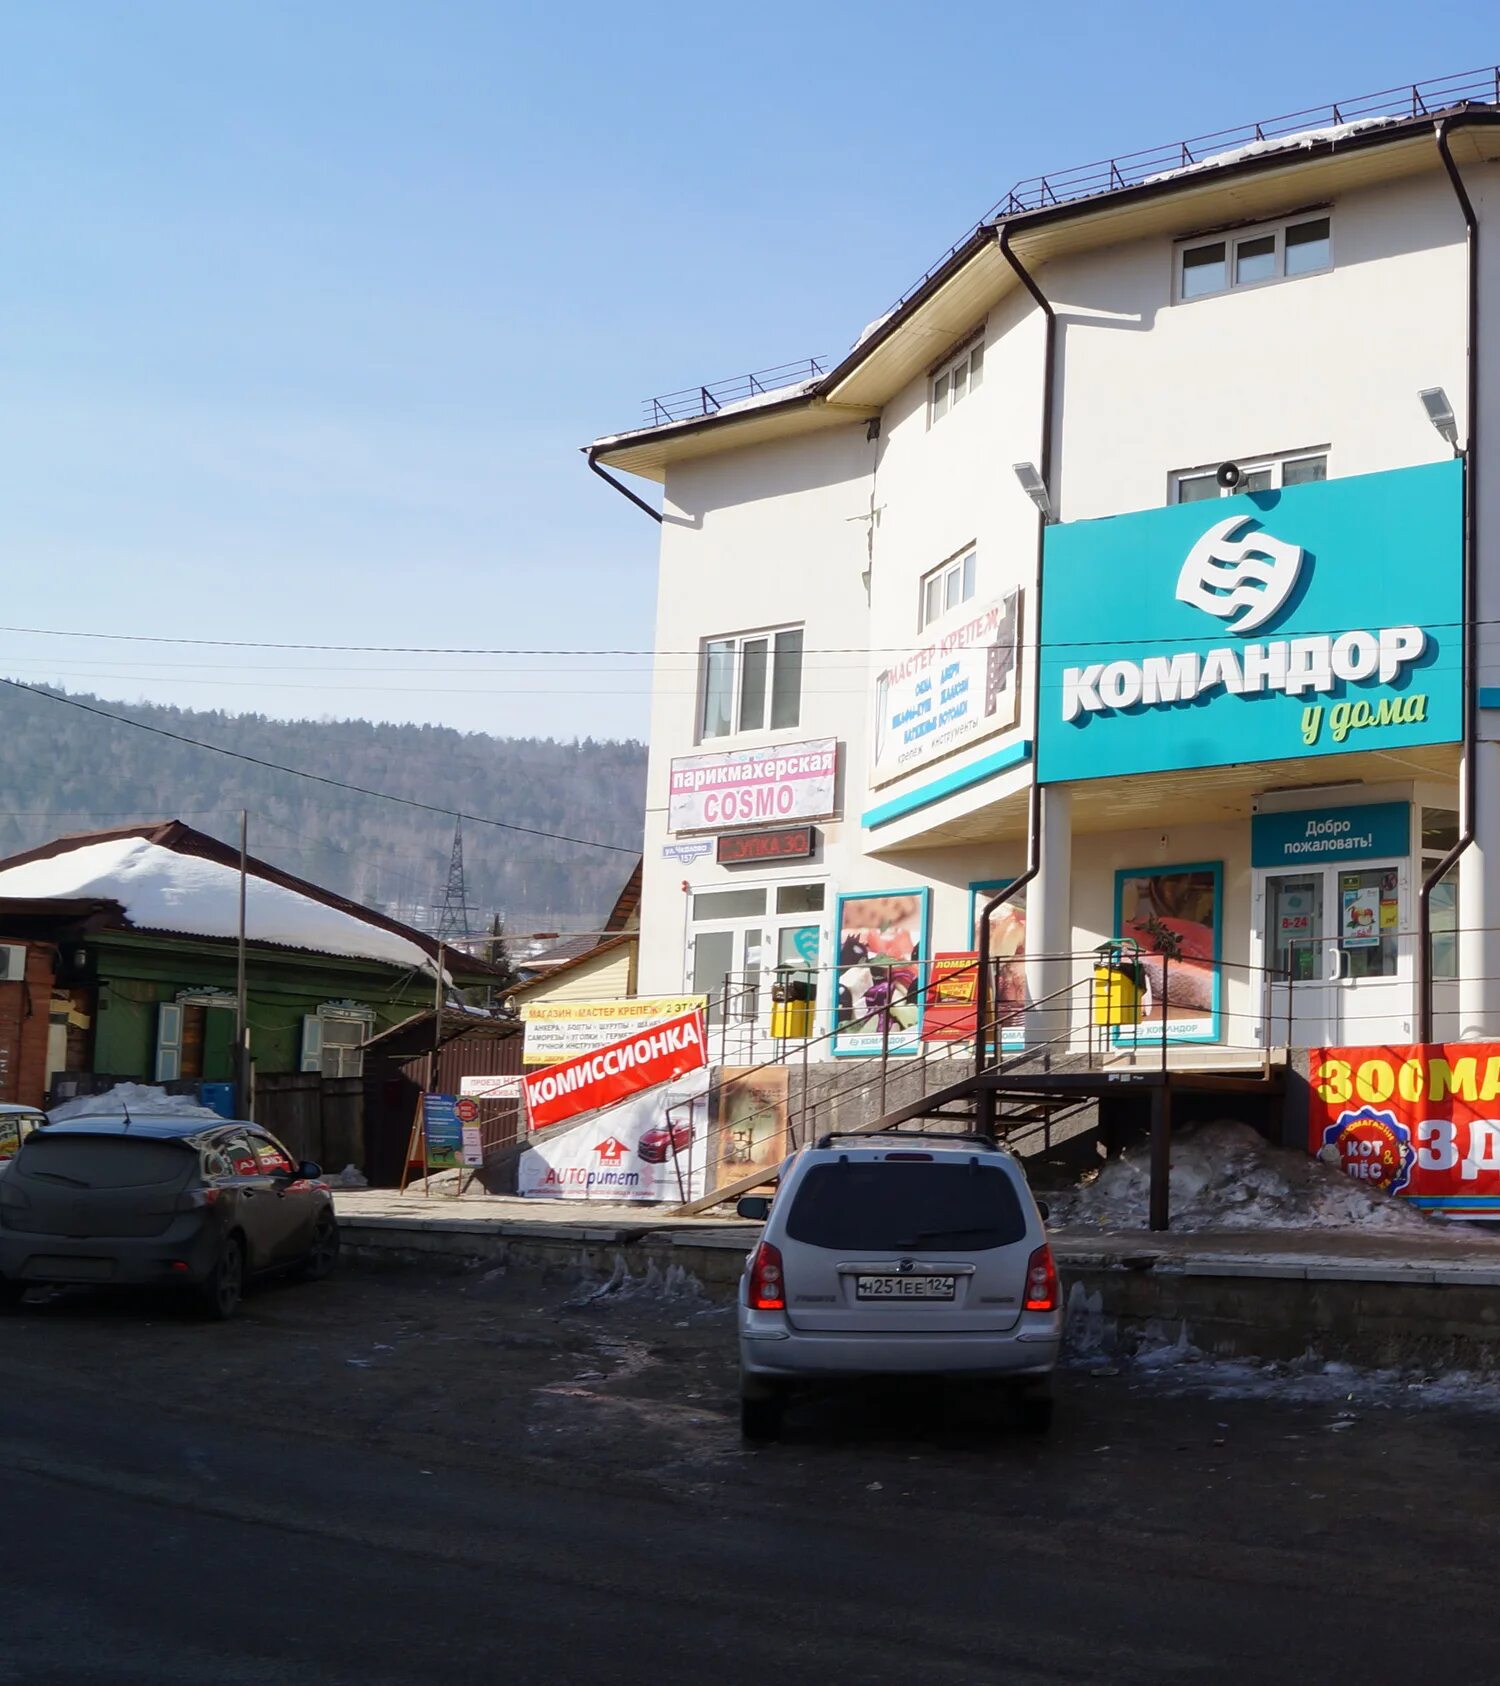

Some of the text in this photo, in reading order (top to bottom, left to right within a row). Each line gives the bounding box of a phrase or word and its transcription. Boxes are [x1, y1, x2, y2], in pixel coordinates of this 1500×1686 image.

[887, 608, 1000, 689] МАСТЕР КРЕПЕЖ
[1062, 625, 1428, 722] КОМАНДОР
[1302, 693, 1428, 746] у дома
[673, 752, 833, 791] парикмахерская
[703, 784, 794, 823] COSMO
[1305, 819, 1351, 837] Добро
[1284, 833, 1373, 854] пожаловать!
[681, 854, 693, 862] 157
[936, 959, 980, 969] ЛОМБАР
[529, 1008, 572, 1018] МАГАЗИН
[528, 1022, 699, 1107] КОМИССИОНКА
[606, 1137, 616, 1157] 2
[1347, 1140, 1384, 1157] КОТ
[1347, 1159, 1382, 1179] ПЁС
[863, 1279, 924, 1295] Н251ЕЕ
